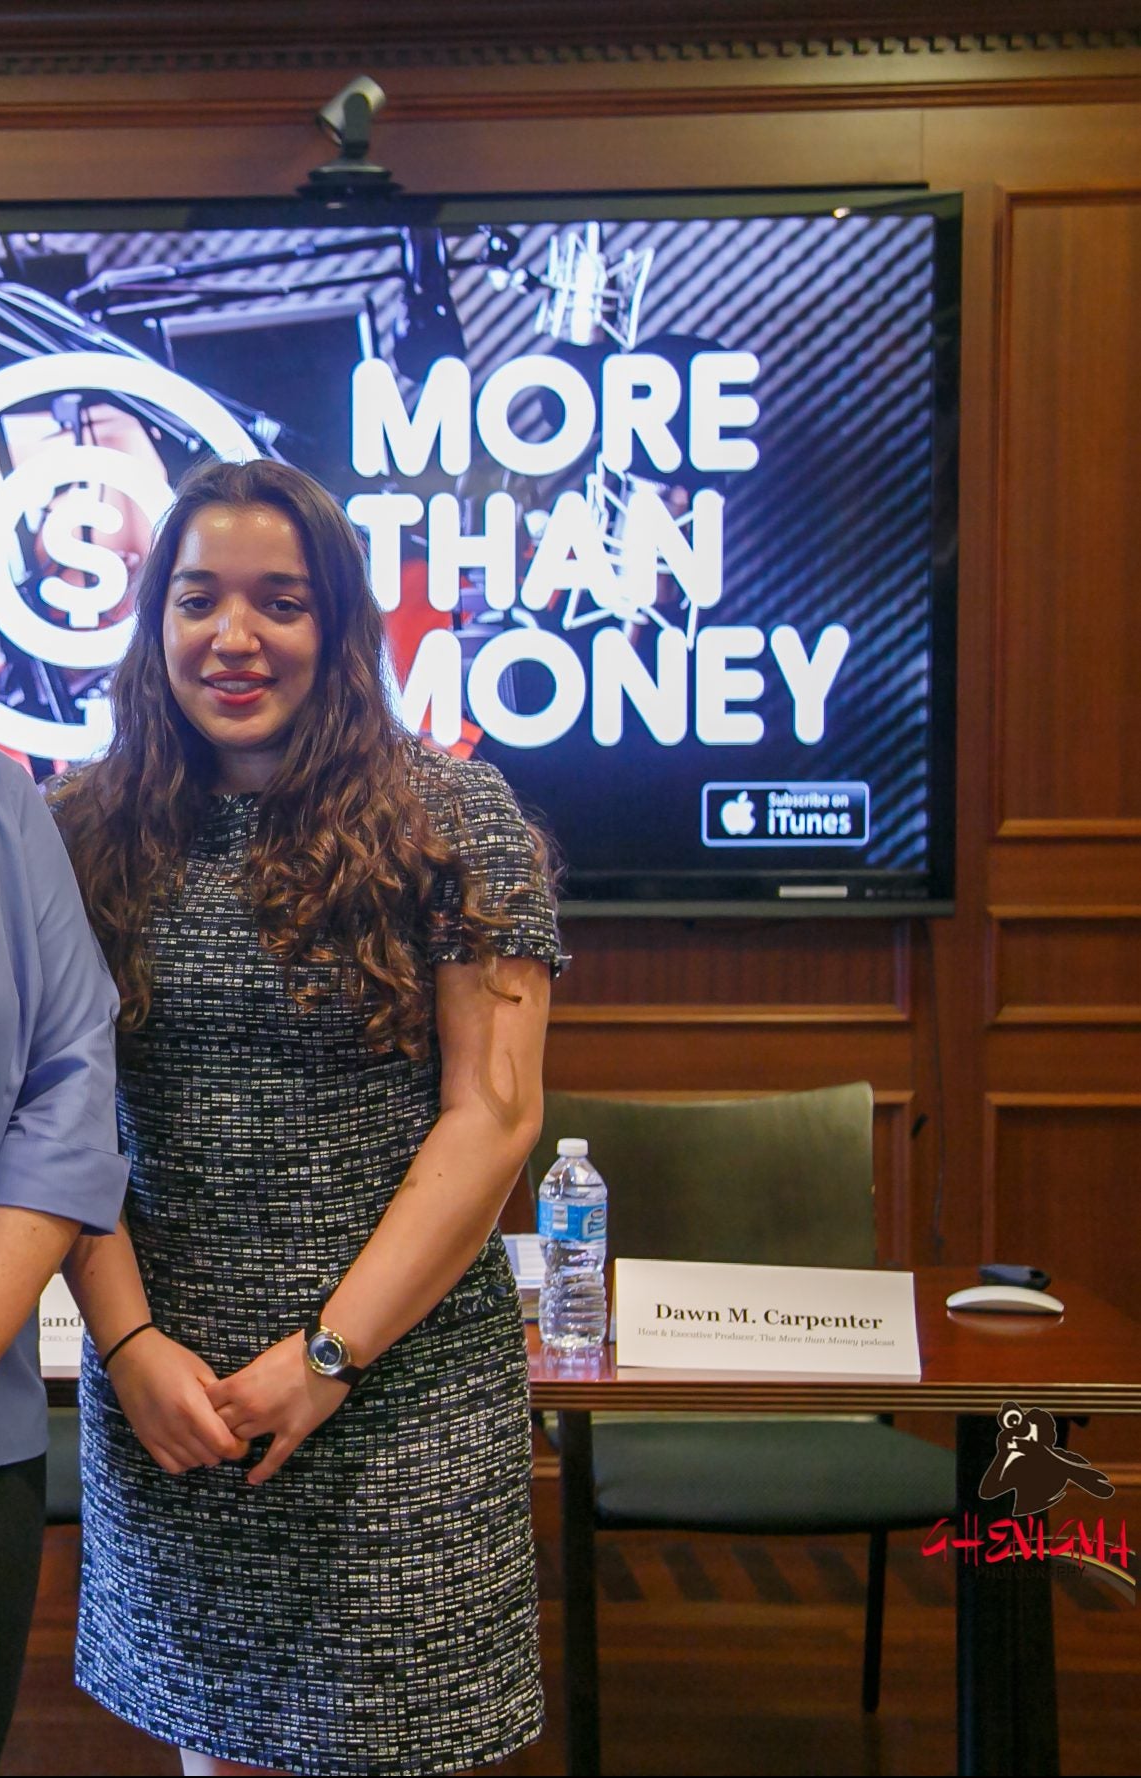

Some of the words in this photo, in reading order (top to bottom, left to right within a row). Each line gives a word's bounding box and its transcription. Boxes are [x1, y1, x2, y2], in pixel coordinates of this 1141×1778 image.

[350, 351, 759, 477] MORE
[346, 489, 725, 611] THAN
[380, 623, 851, 748] MONEY
[768, 792, 830, 808] Subscribe
[831, 794, 850, 808] on
[768, 808, 851, 835] iTunes
[655, 1303, 720, 1322] Dawn
[727, 1307, 757, 1324] M.
[763, 1308, 884, 1331] Carpenter
[638, 1327, 658, 1337] Host
[660, 1328, 668, 1337] &
[670, 1329, 713, 1340] Executive
[714, 1331, 757, 1343] Producer,
[759, 1334, 777, 1343] The
[778, 1334, 802, 1343] More
[804, 1336, 826, 1345] than
[827, 1337, 859, 1347] Money
[860, 1338, 896, 1348] podcast
